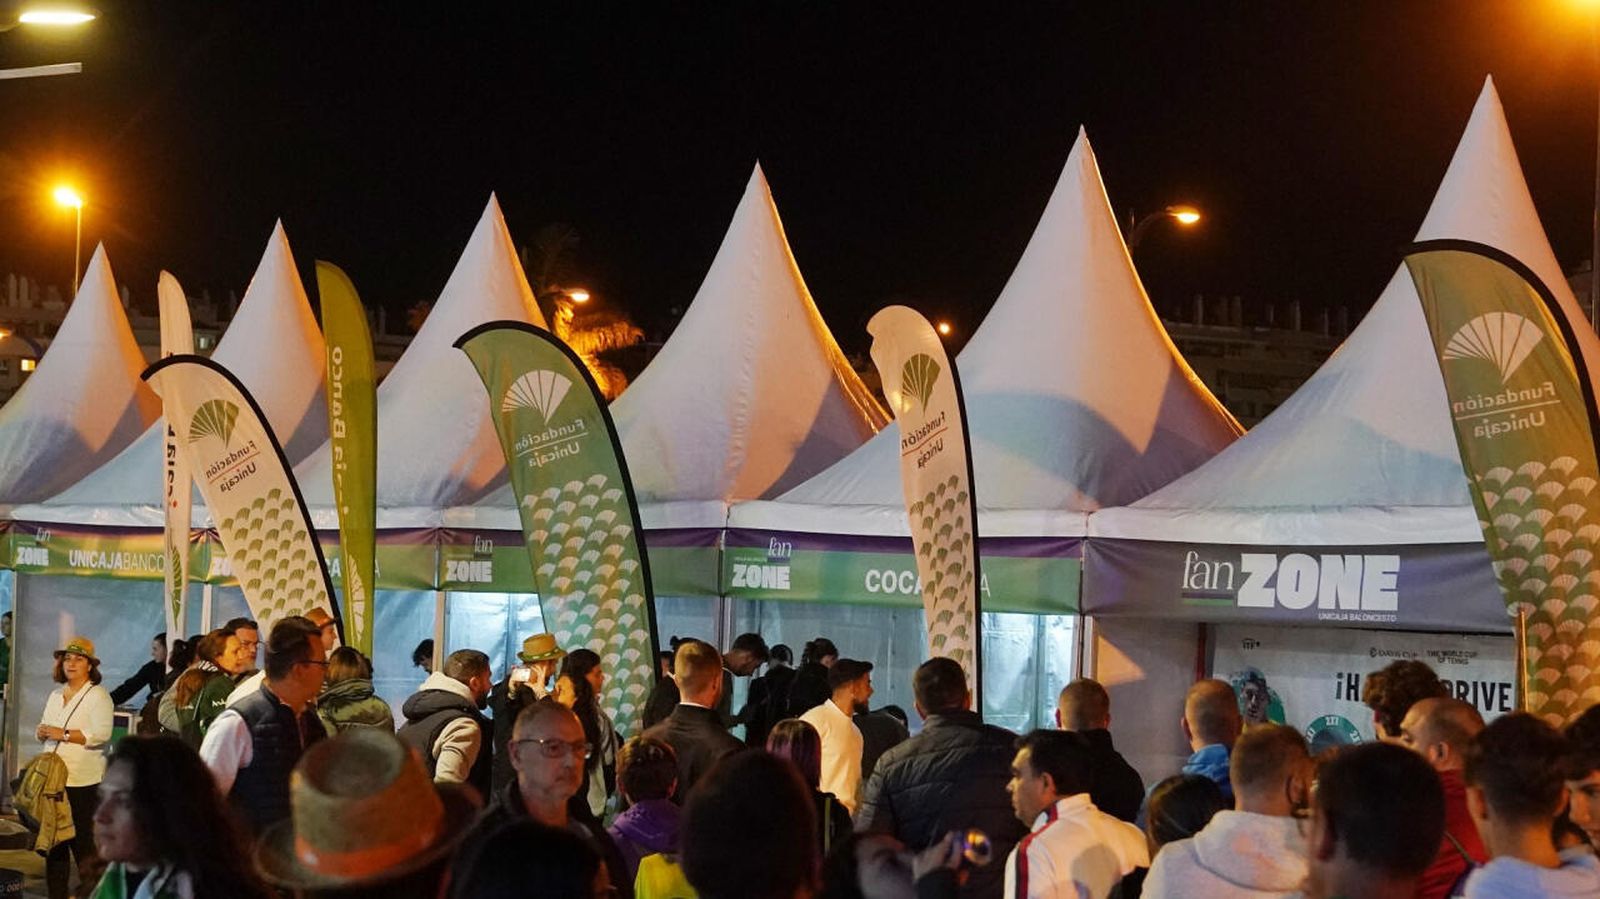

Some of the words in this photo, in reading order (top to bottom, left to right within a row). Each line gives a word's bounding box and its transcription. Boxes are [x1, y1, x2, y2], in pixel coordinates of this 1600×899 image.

[36, 527, 51, 542] fan
[474, 535, 493, 553] fan
[16, 547, 49, 566] ZONE
[768, 536, 792, 558] fan
[446, 560, 493, 583] ZONE
[732, 563, 791, 590] ZONE
[1181, 550, 1234, 591] fan
[1237, 553, 1401, 611] ZONE
